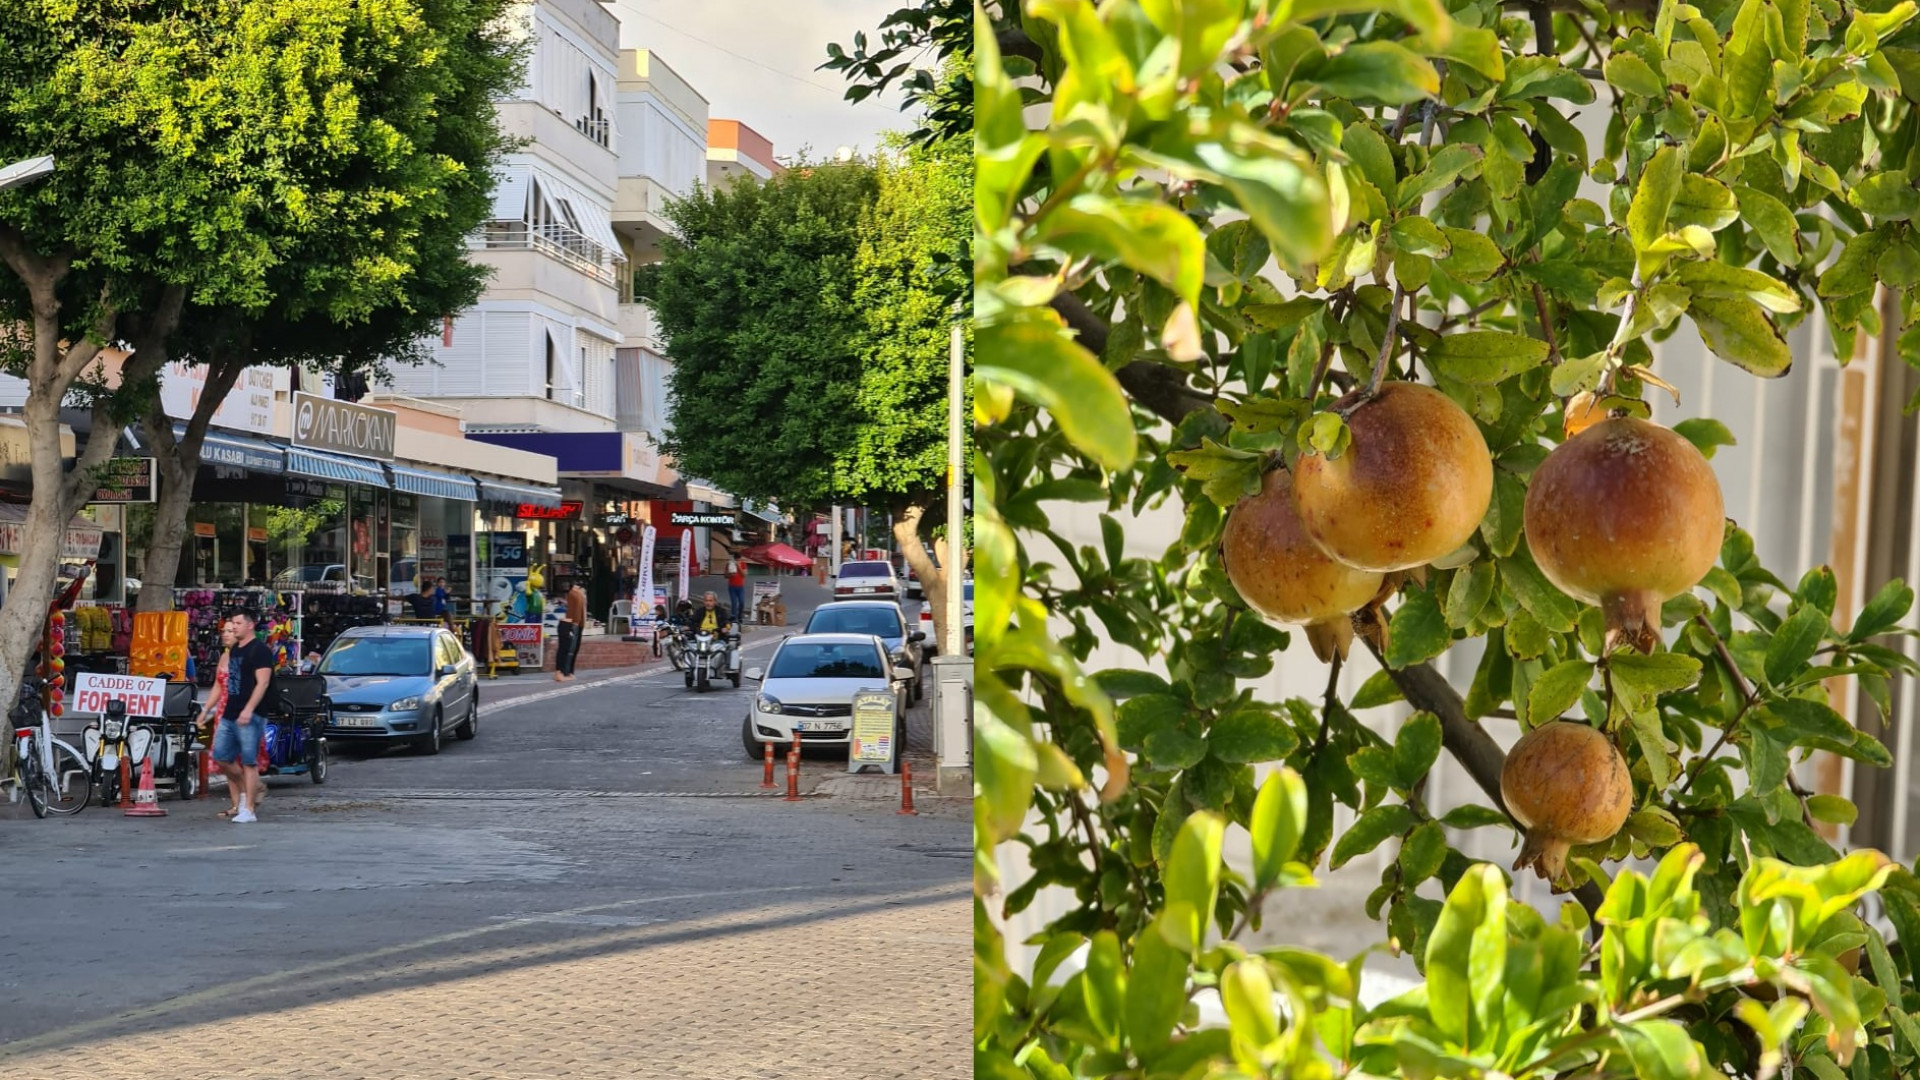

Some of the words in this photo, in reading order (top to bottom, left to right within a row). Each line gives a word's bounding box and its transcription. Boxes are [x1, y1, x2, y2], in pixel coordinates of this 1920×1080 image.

[214, 447, 244, 464] KASABI
[88, 676, 134, 691] CADDE
[138, 680, 154, 692] 07
[78, 690, 112, 713] FOR
